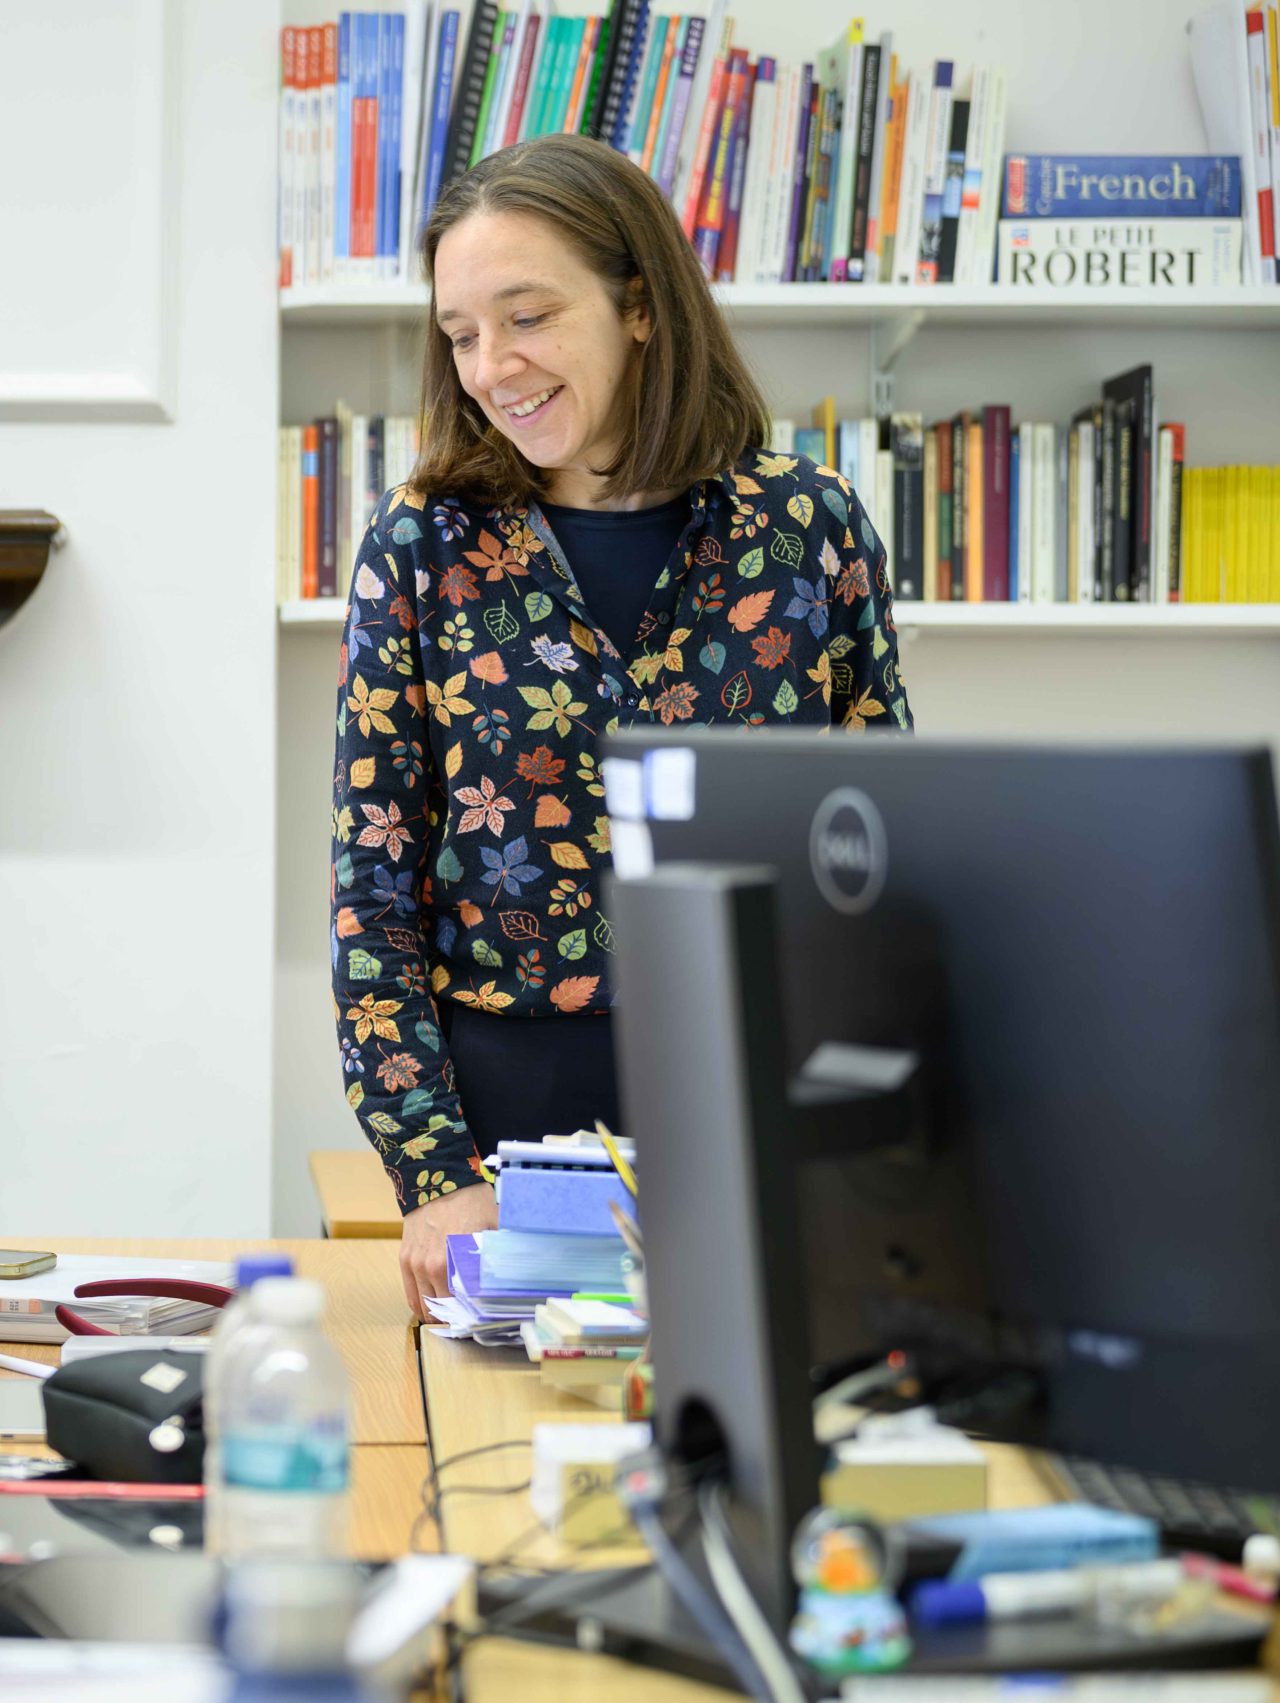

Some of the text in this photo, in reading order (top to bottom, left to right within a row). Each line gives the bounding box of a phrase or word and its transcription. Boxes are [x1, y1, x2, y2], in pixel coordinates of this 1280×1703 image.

[1054, 162, 1196, 200] French
[1055, 226, 1158, 246] LE PETIT
[1011, 249, 1202, 286] ROBERT
